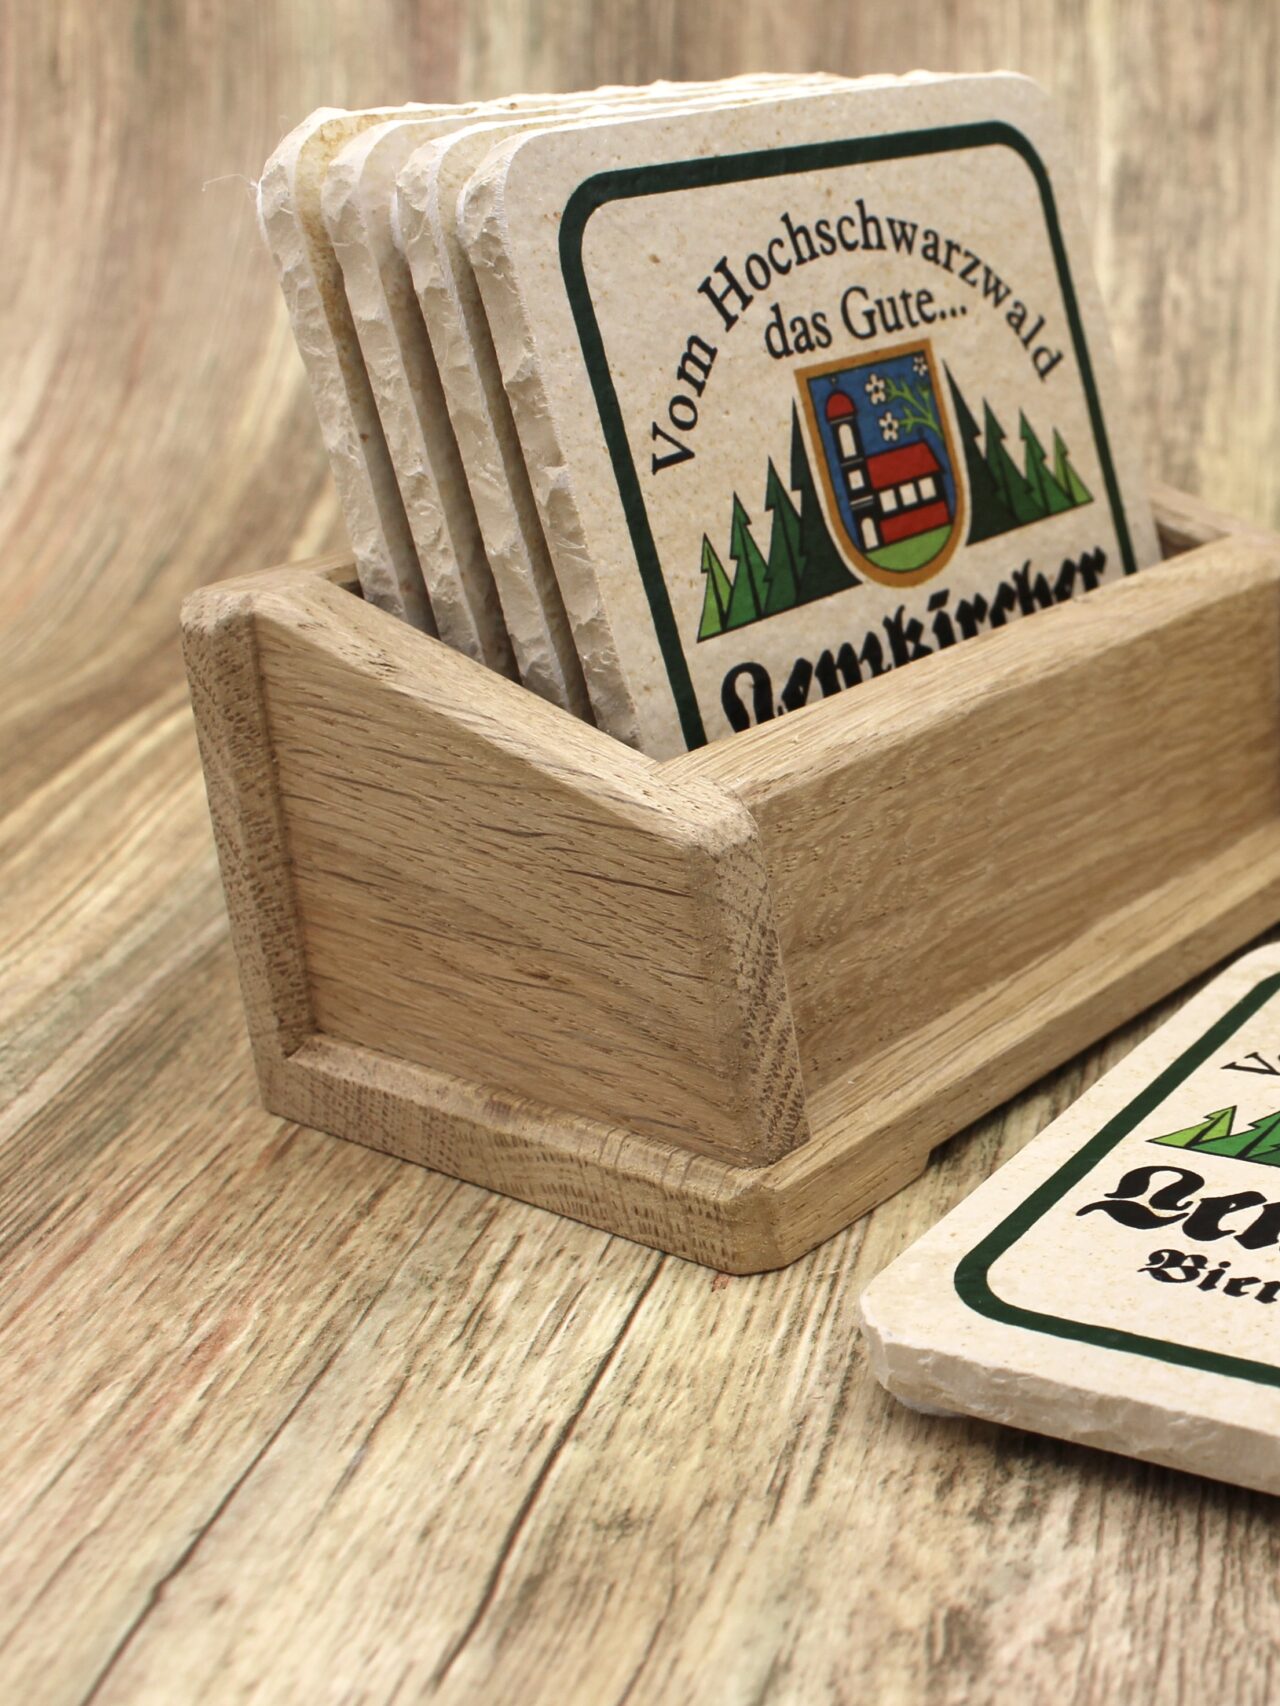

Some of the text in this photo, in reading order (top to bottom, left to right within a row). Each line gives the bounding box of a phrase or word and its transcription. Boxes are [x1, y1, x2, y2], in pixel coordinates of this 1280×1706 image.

[651, 199, 1063, 475] Vom Hochschwarzwald
[764, 286, 968, 360] das Gute...
